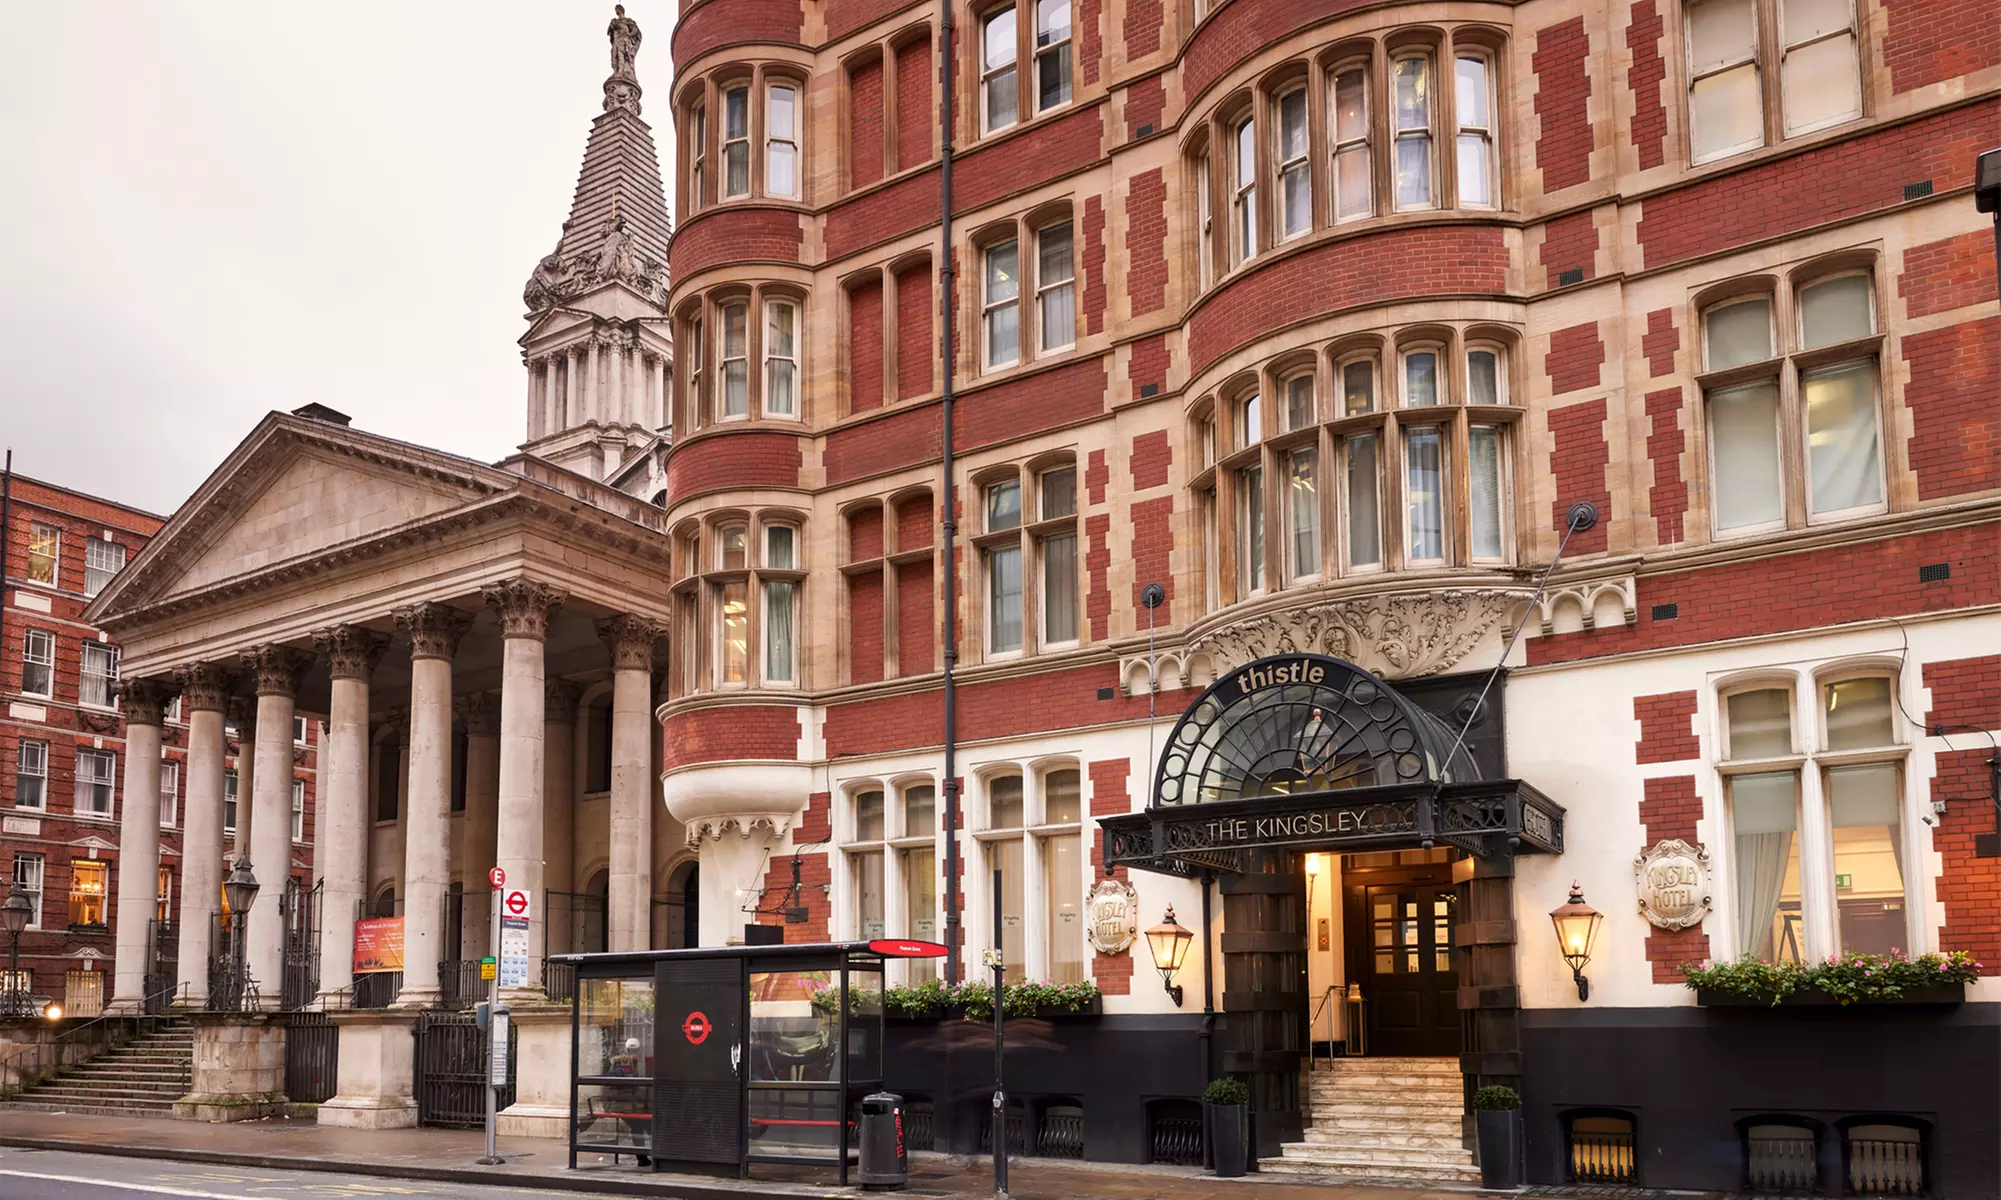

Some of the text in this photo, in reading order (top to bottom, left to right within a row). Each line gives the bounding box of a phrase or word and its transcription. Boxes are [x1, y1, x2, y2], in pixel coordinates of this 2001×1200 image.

[1238, 659, 1325, 694] thistle
[1206, 810, 1367, 841] THE KINGSLEY
[494, 870, 503, 885] E
[1647, 864, 1699, 890] KINGSLEY
[1652, 888, 1696, 908] HOTEL
[1095, 918, 1125, 936] HOTEL
